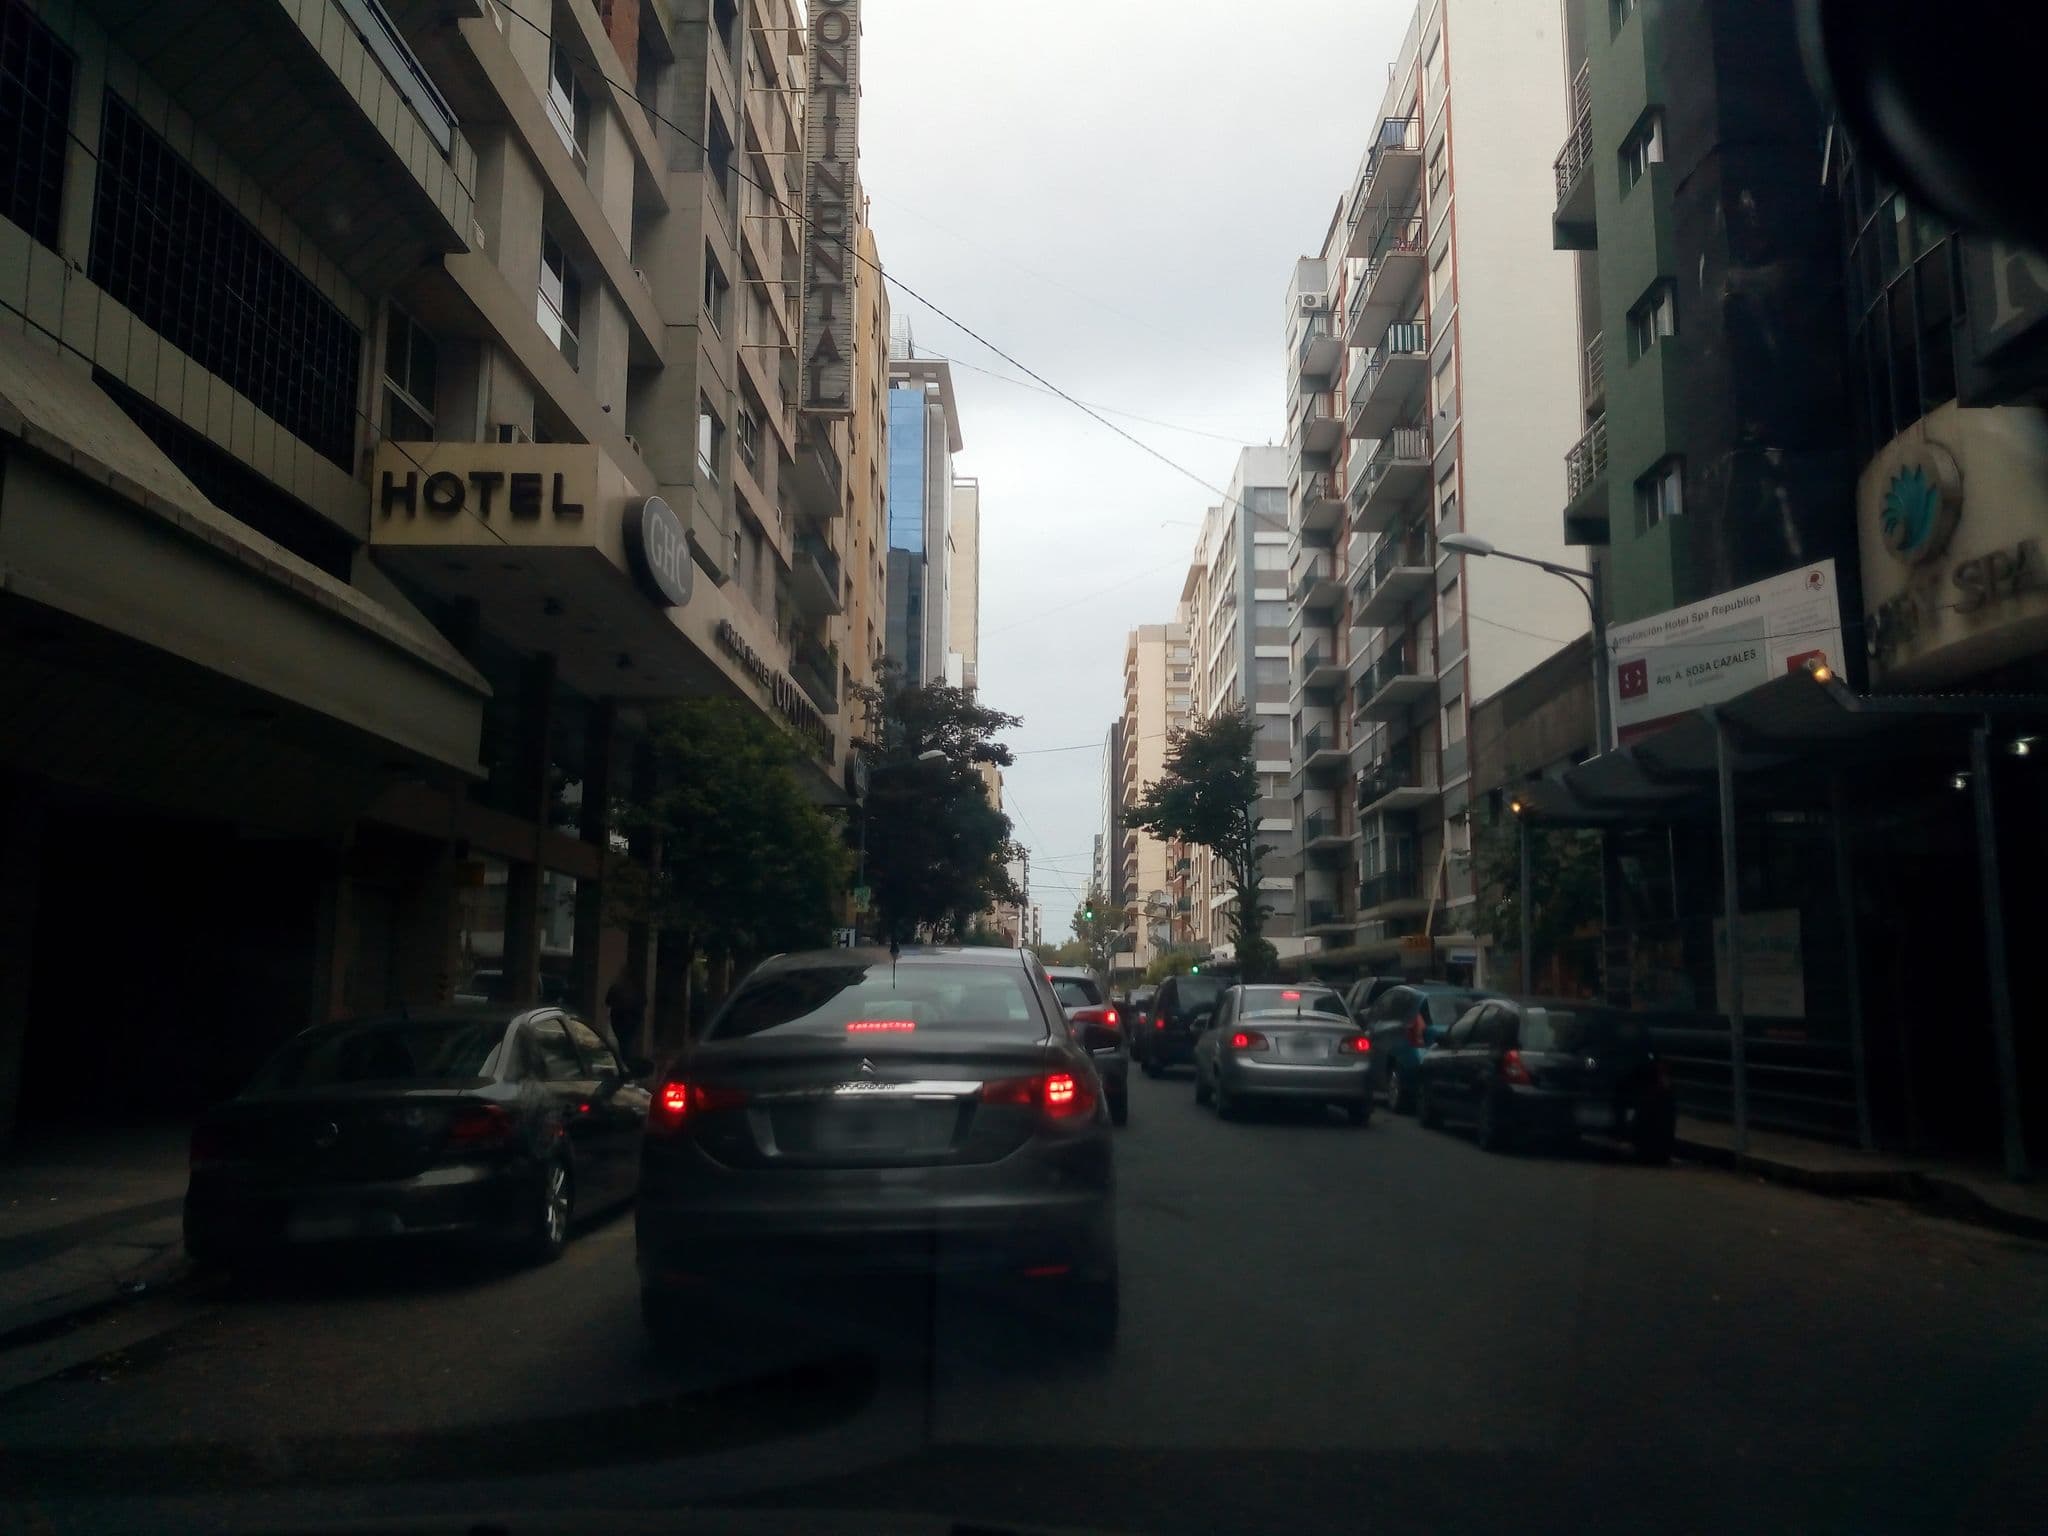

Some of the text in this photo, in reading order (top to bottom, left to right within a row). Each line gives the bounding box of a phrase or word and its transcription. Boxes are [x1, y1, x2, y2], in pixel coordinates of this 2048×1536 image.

[807, 0, 852, 408] ONTINENTAL
[380, 471, 584, 520] HOTEL
[651, 512, 687, 594] GHC
[1665, 616, 1689, 631] Hotel
[1686, 661, 1712, 677] SOSA
[1713, 649, 1756, 670] CAZALES
